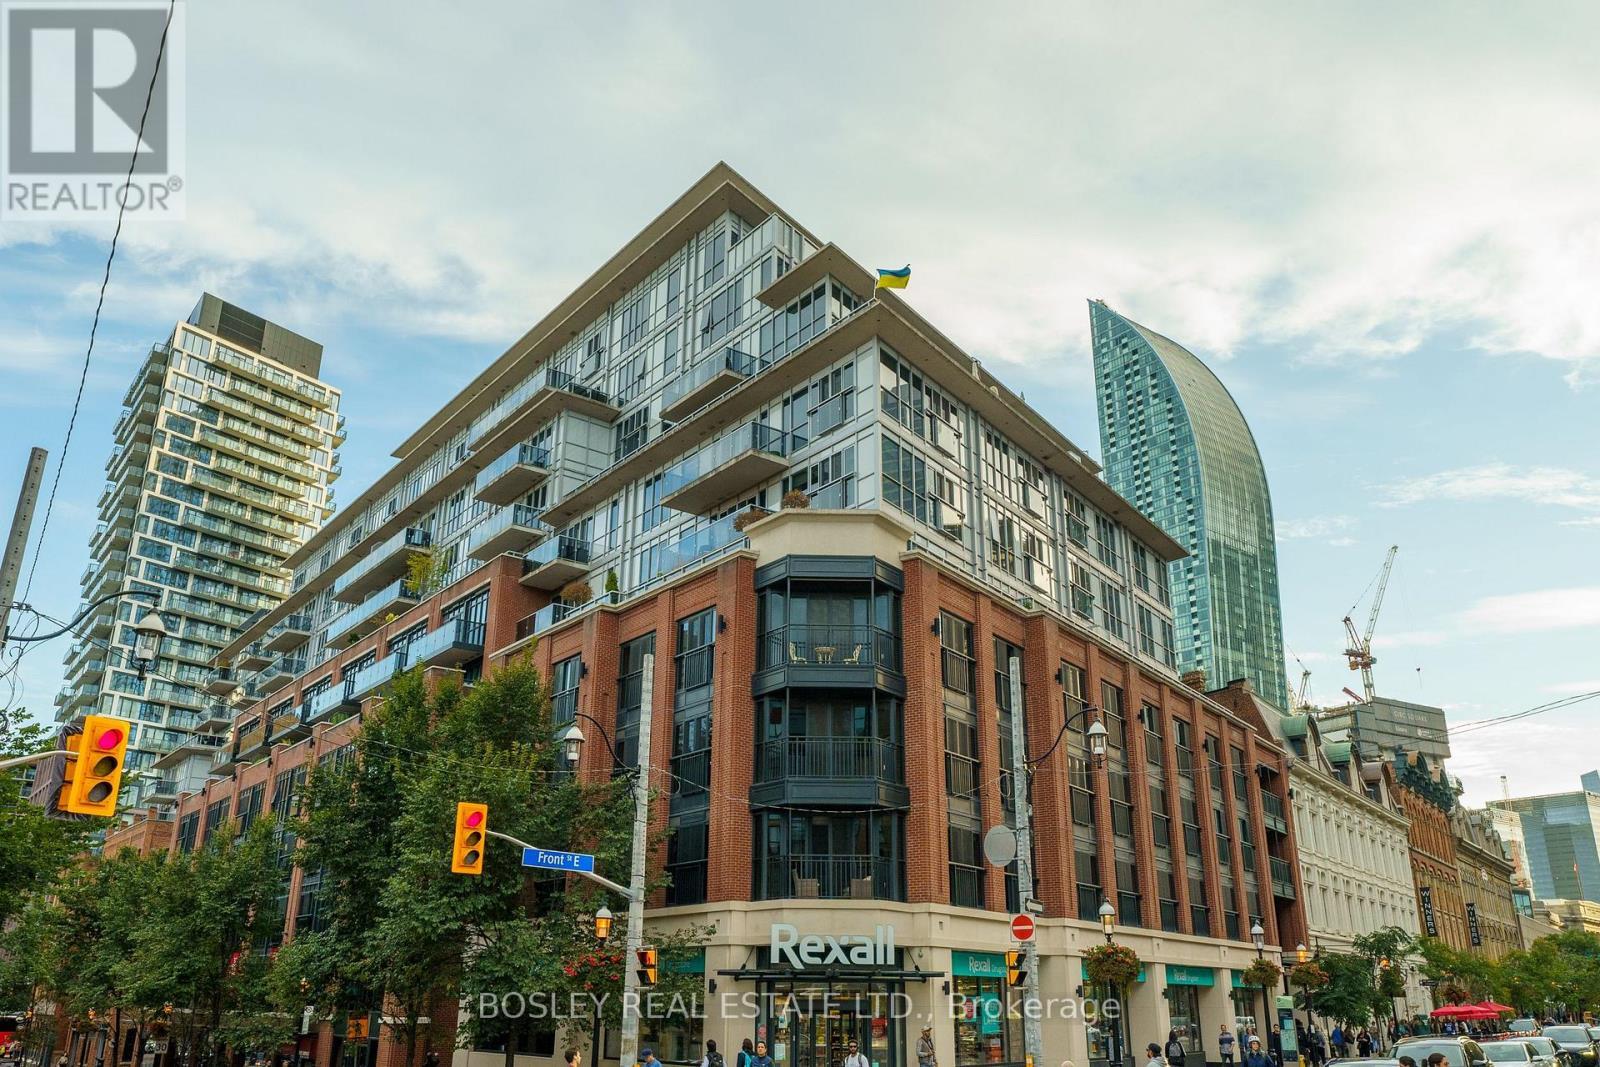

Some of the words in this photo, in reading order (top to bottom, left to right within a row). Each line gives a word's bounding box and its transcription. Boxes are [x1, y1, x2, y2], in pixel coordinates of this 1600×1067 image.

[538, 852, 564, 865] Front
[573, 855, 580, 867] E
[1421, 890, 1436, 934] WINNERS
[1466, 905, 1479, 944] WINNERS
[770, 923, 895, 969] Rexall
[968, 956, 991, 974] Rexall
